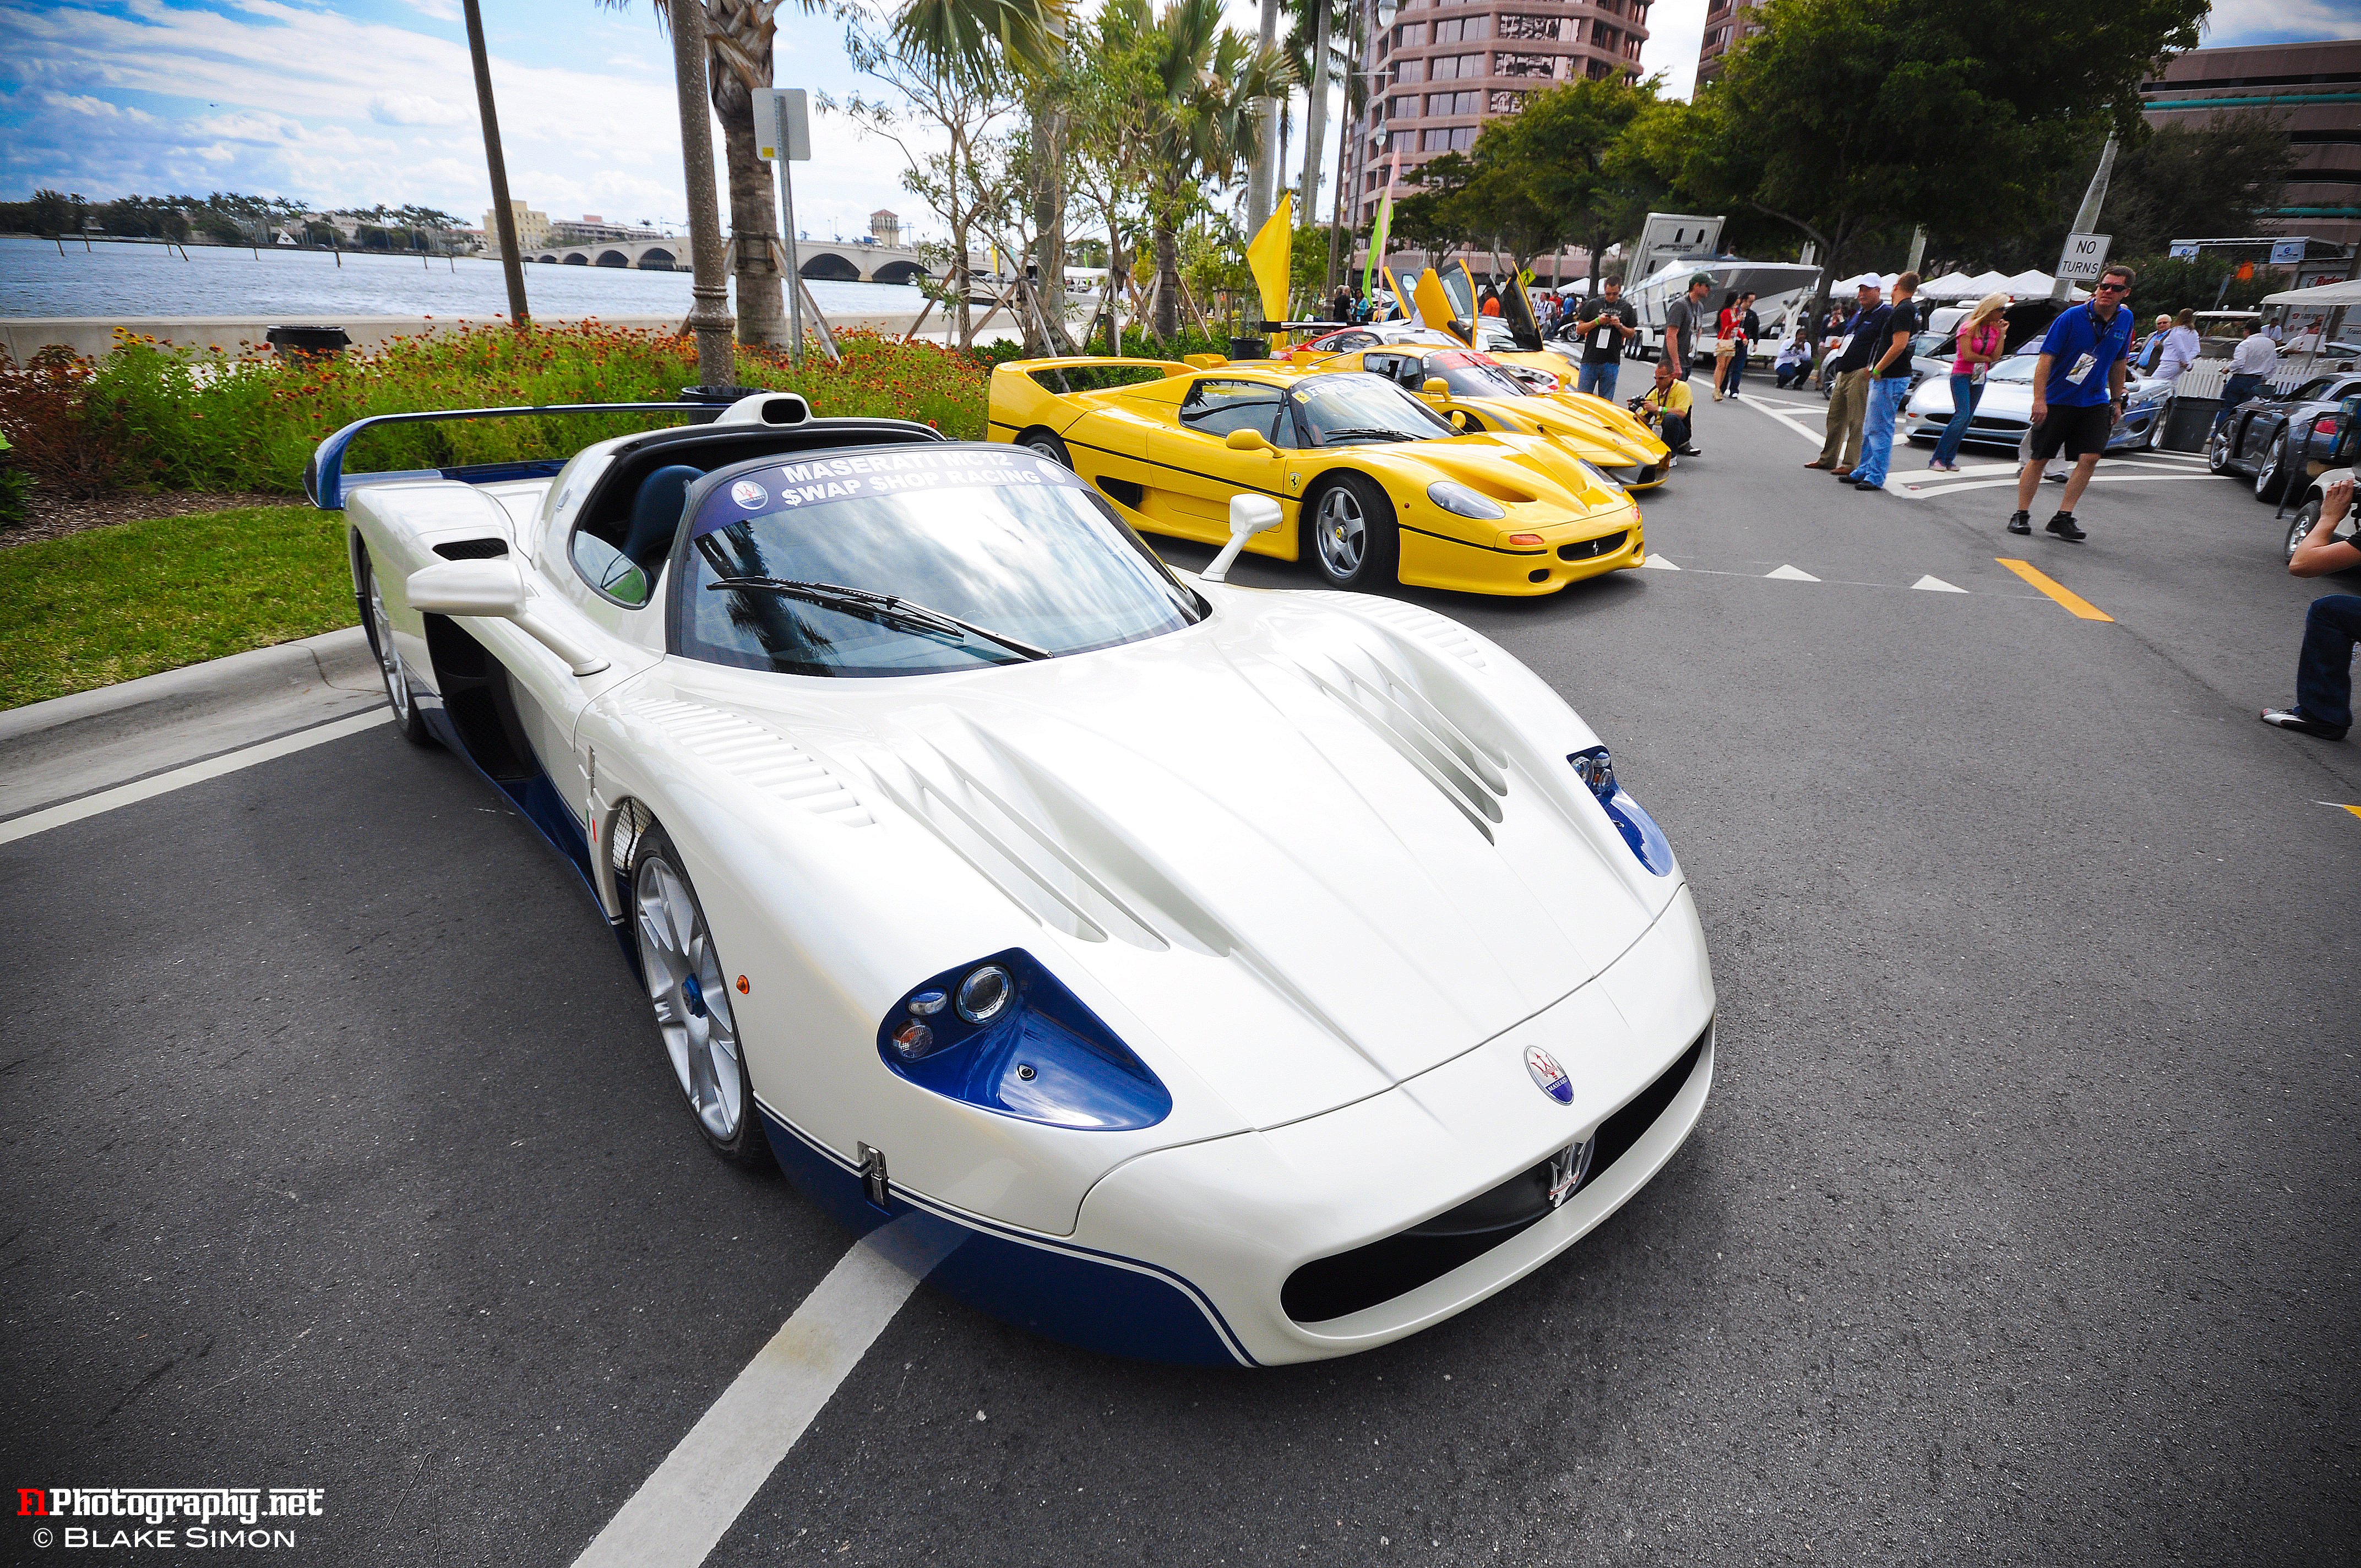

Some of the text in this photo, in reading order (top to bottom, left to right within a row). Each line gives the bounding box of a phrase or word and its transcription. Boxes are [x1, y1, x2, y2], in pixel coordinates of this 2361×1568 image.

[2076, 240, 2097, 254] NO
[2063, 260, 2099, 274] TURNS
[781, 451, 1014, 483] MASERATI MC12
[944, 470, 1042, 484] RACING
[1547, 1077, 1569, 1092] MASERATI
